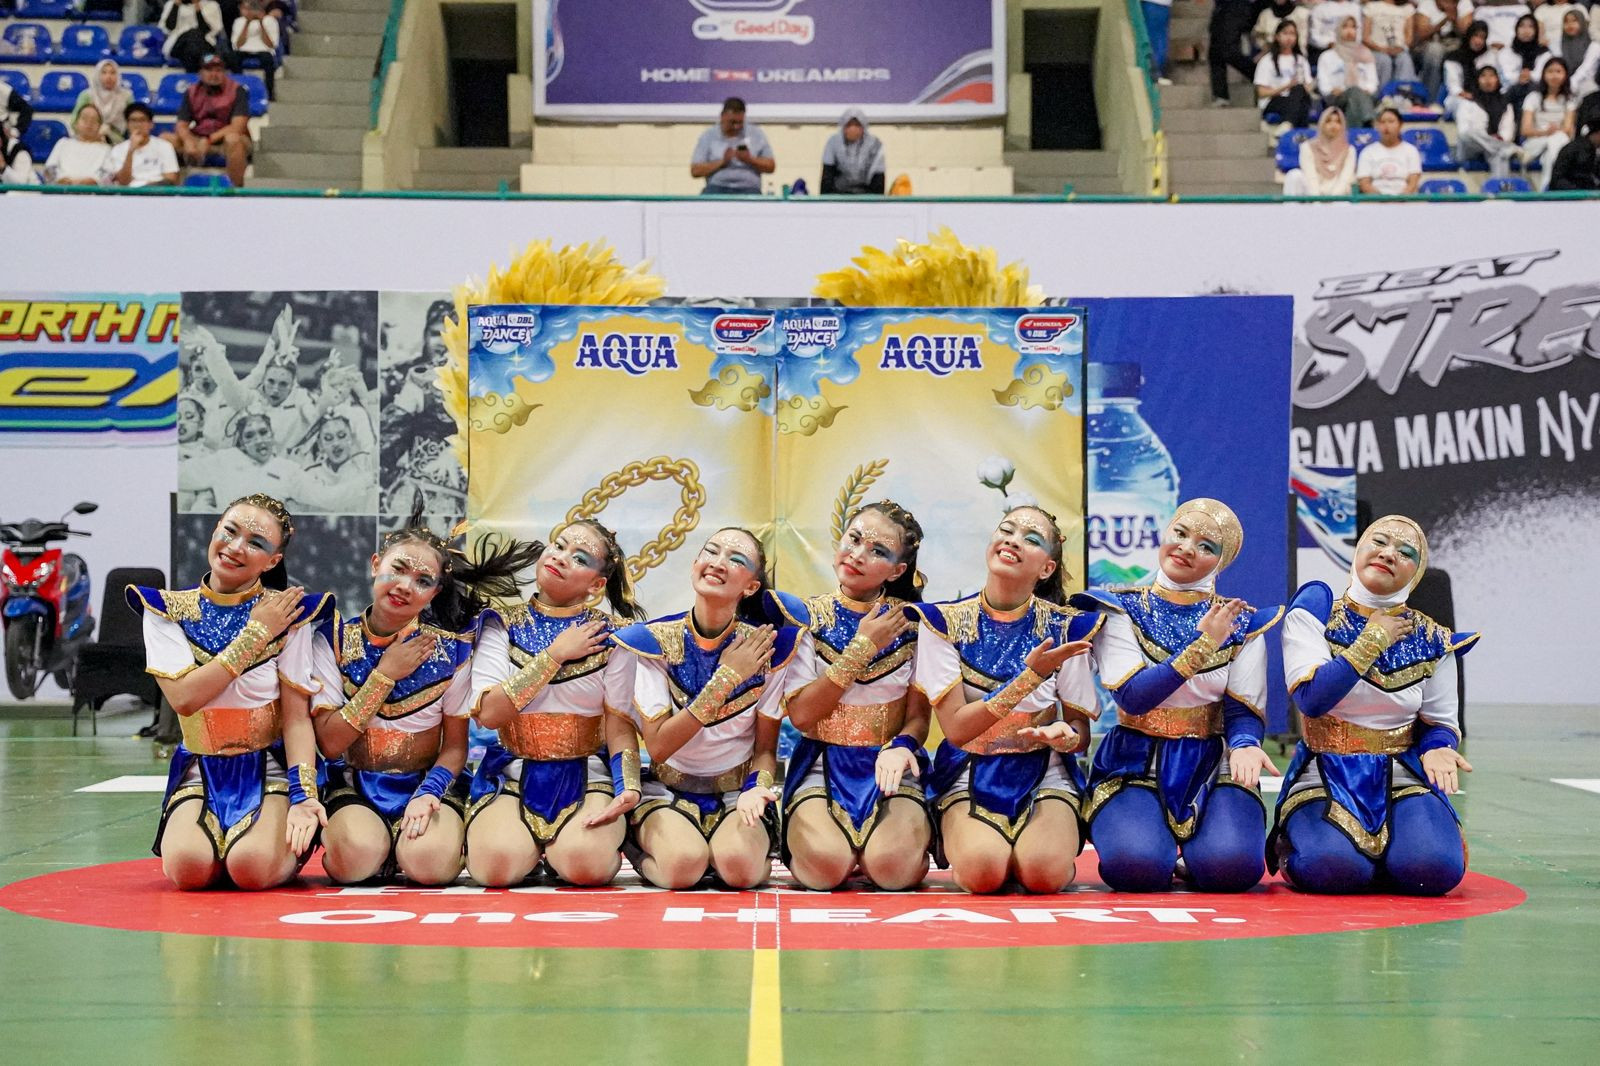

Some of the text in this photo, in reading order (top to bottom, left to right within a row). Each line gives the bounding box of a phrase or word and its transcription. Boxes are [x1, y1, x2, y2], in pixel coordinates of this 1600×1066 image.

[641, 68, 710, 82] HOME
[757, 68, 891, 82] DREAMERS
[478, 315, 533, 327] AQUA DBL
[783, 319, 812, 331] AQUA
[576, 335, 677, 374] AQUA
[880, 336, 982, 375] AQUA
[1290, 420, 1384, 475] GAYA
[1395, 403, 1526, 470] MAKIN
[279, 906, 1248, 925] One HEART.
